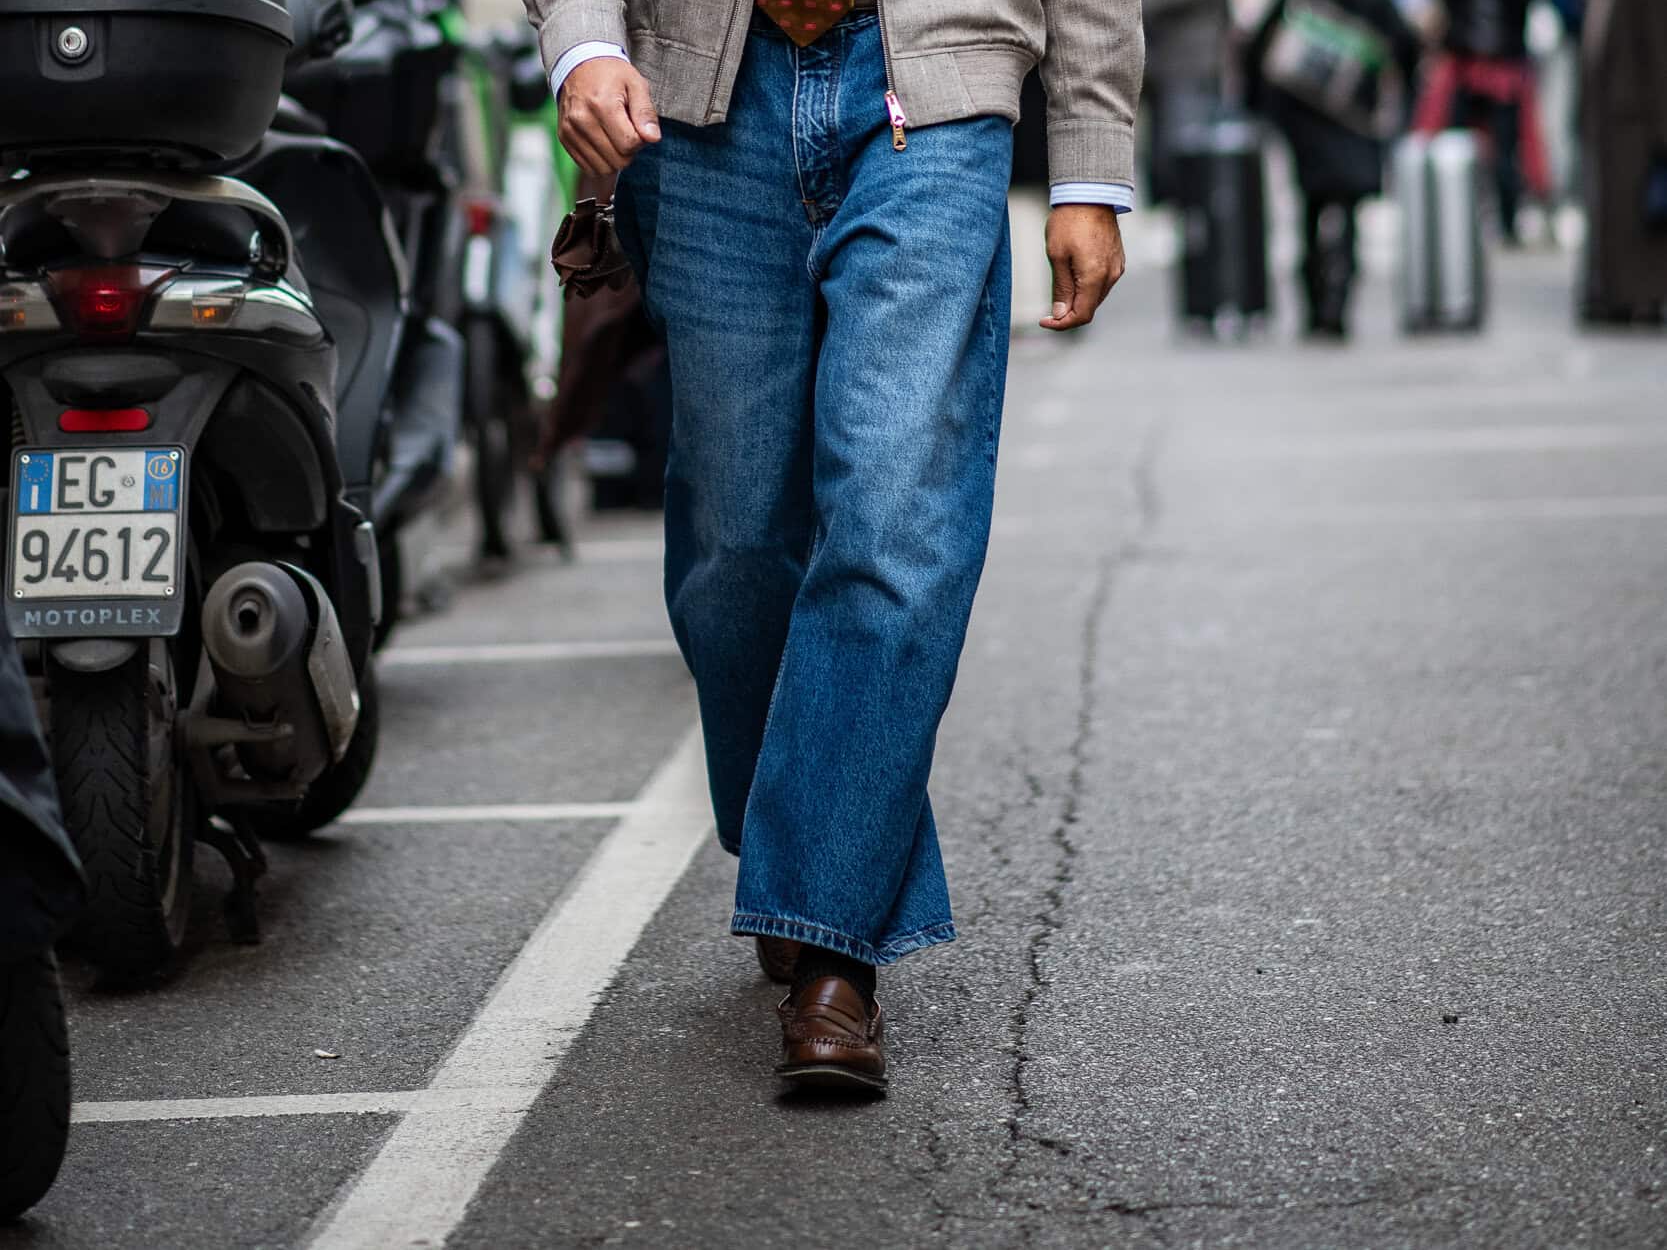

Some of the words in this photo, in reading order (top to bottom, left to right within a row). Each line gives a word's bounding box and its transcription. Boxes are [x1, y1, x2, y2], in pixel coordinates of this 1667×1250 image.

[31, 485, 39, 510] I
[57, 456, 116, 510] EG
[22, 527, 170, 584] 94612
[24, 608, 161, 626] MOTOPLEX
